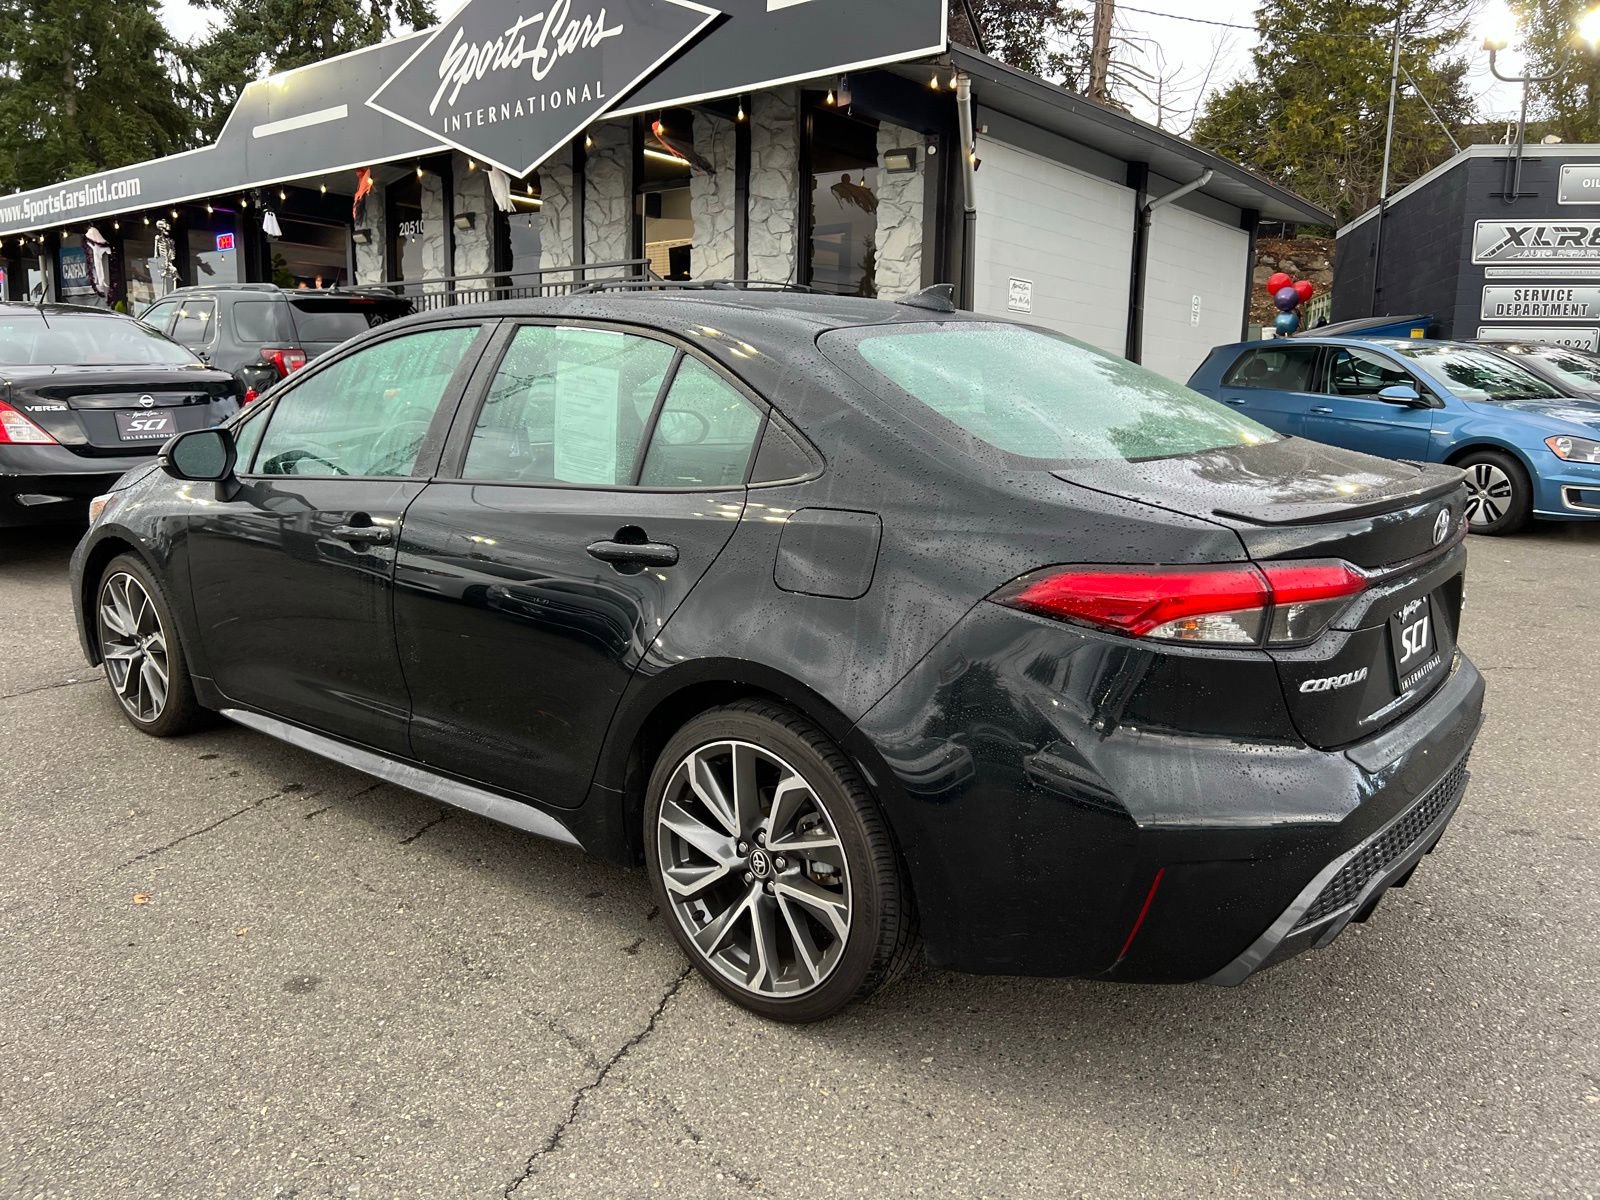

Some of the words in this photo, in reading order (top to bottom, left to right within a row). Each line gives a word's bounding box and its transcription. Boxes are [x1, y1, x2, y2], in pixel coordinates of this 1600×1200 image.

[429, 12, 546, 116] Sports
[531, 0, 623, 81] Cars
[444, 81, 605, 133] INTERNATIONAL
[1496, 303, 1589, 316] DEPARTMENT
[1513, 289, 1573, 301] SERVICE
[127, 418, 168, 431] SCI
[1400, 615, 1428, 664] SCI
[1300, 666, 1368, 693] COROLLA
[1401, 655, 1441, 691] INTERNATIONAL
